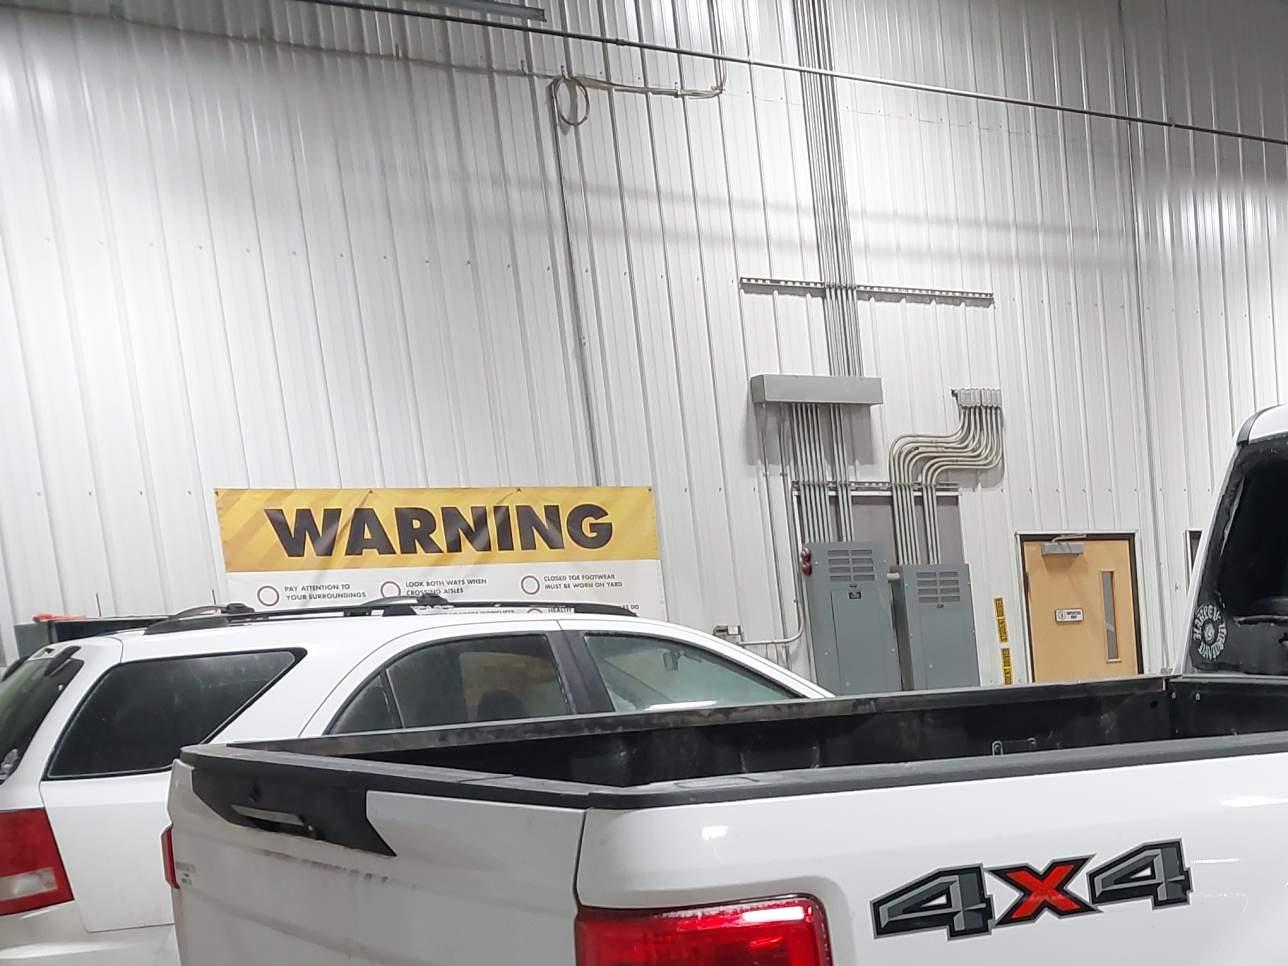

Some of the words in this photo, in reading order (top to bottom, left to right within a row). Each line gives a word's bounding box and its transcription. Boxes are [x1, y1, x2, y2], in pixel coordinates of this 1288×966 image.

[264, 503, 613, 558] WARNING
[581, 573, 615, 581] FOOTWEAR
[284, 585, 298, 593] PAY
[301, 584, 339, 592] ATTENTION
[405, 580, 424, 588] LOOK
[426, 580, 445, 588] BOTH
[286, 593, 307, 601] YOUR
[308, 592, 367, 600] SURROUNDINGS
